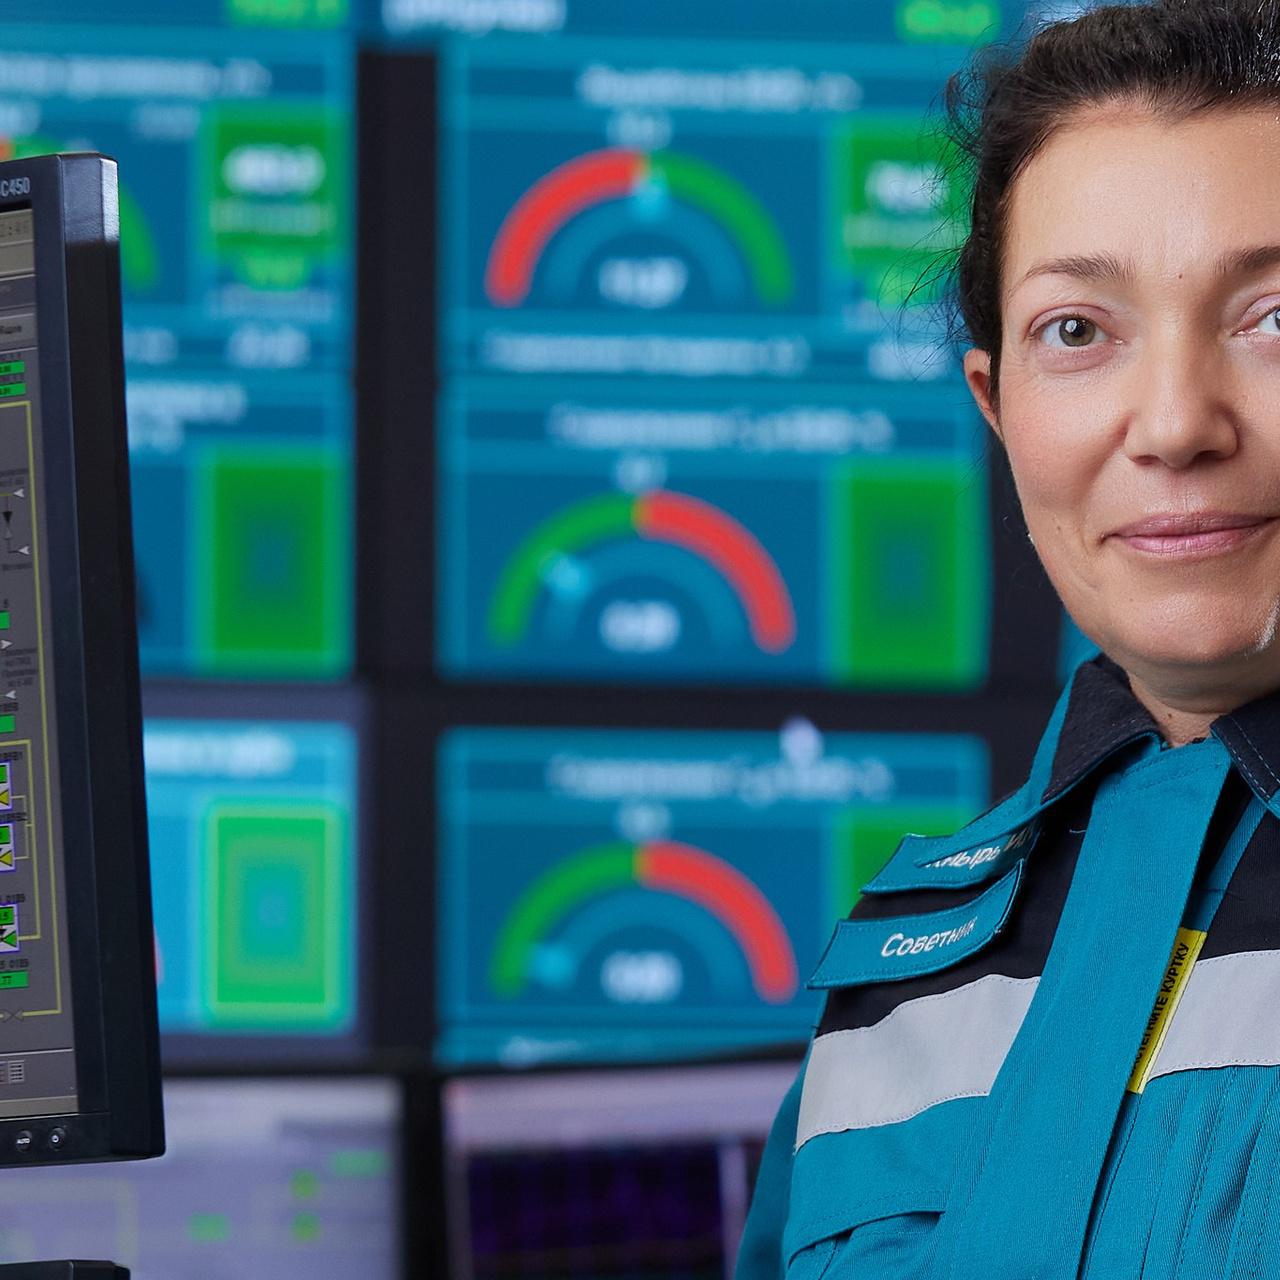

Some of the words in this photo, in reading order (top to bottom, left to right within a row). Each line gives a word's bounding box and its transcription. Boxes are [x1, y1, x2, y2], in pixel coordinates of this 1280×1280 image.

[0, 177, 30, 197] C450
[880, 916, 978, 957] Советник
[1160, 942, 1190, 994] КУРТКУ
